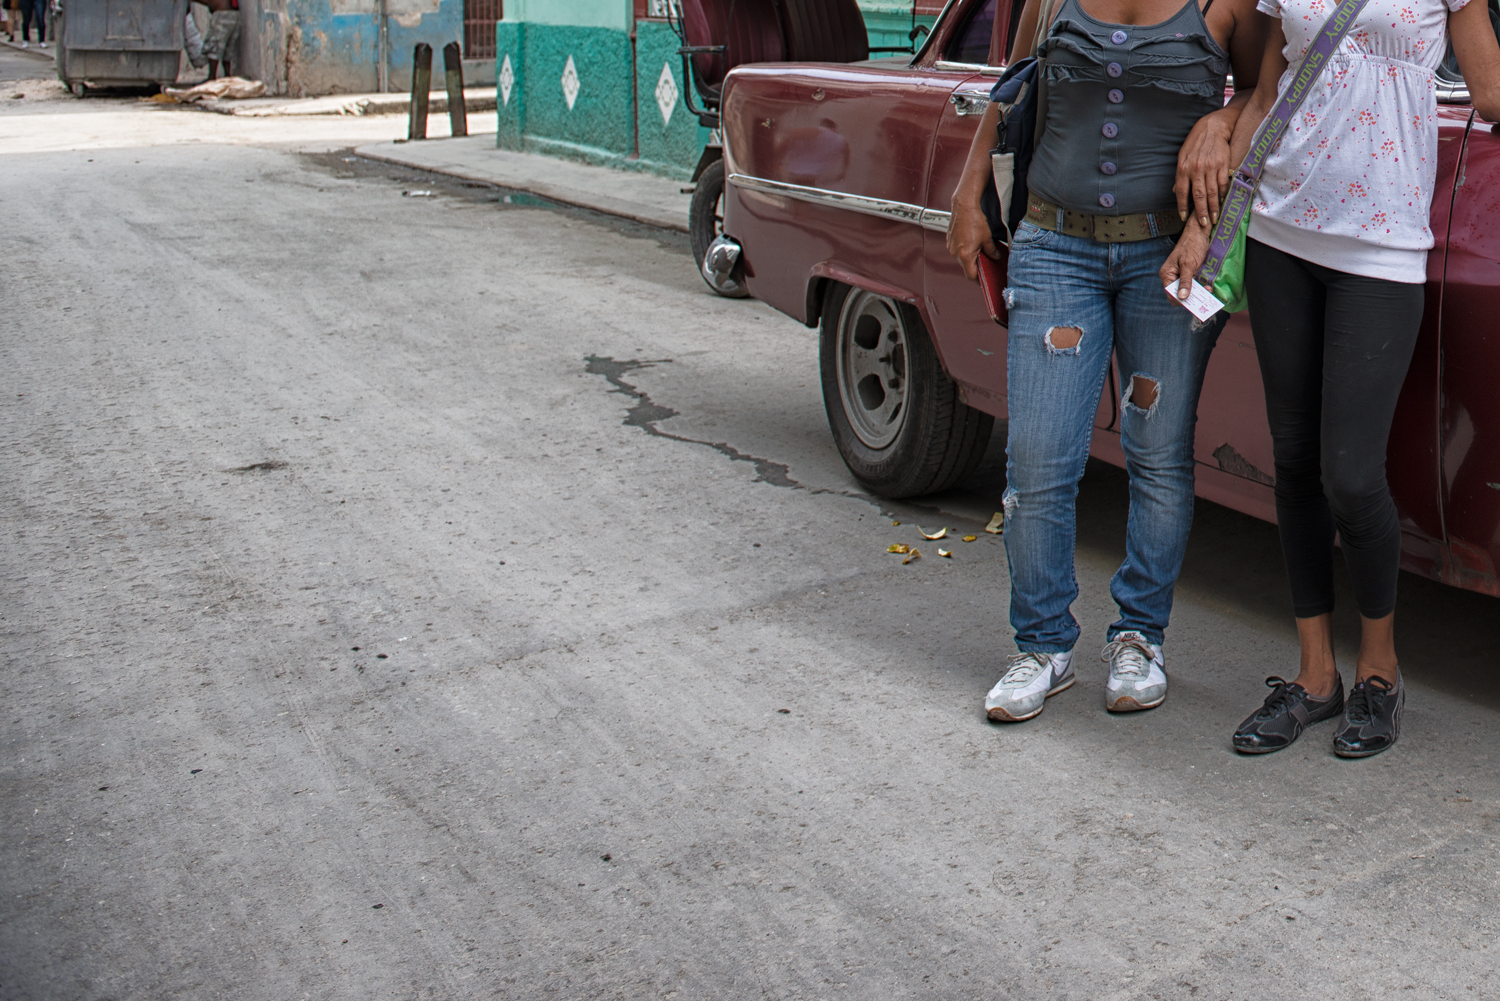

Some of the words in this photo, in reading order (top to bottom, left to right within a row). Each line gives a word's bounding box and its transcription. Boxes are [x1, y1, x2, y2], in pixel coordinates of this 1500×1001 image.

[1286, 50, 1324, 111] SNOOPY
[1247, 116, 1283, 176] SNOOPY
[1216, 185, 1248, 248] SNOOPY
